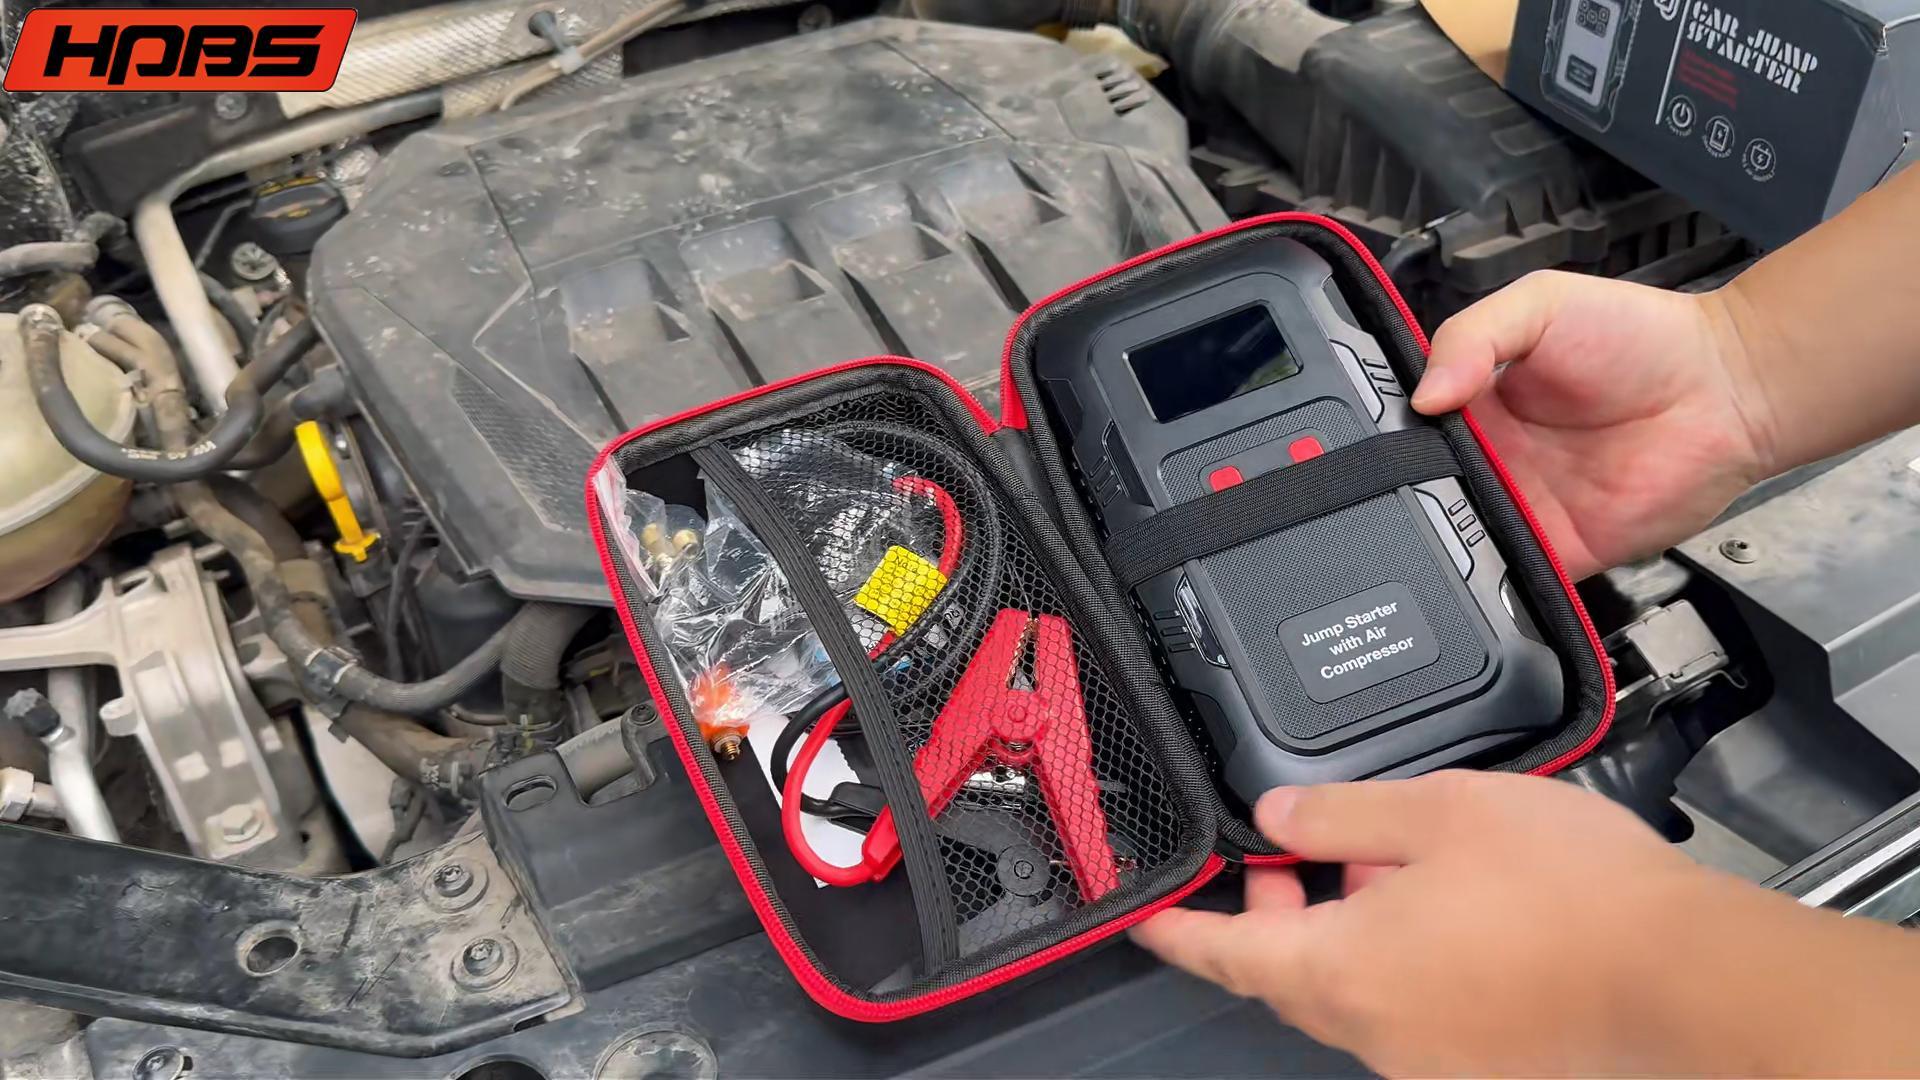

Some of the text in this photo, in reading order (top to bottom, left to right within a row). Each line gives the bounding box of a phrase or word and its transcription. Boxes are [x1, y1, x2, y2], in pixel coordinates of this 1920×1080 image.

[1687, 21, 1801, 94] STARTER
[1692, 1, 1818, 73] CAR JUMP
[1302, 602, 1398, 646] Jump Starter
[1329, 625, 1387, 656] with Air
[1320, 637, 1414, 680] Compressor
